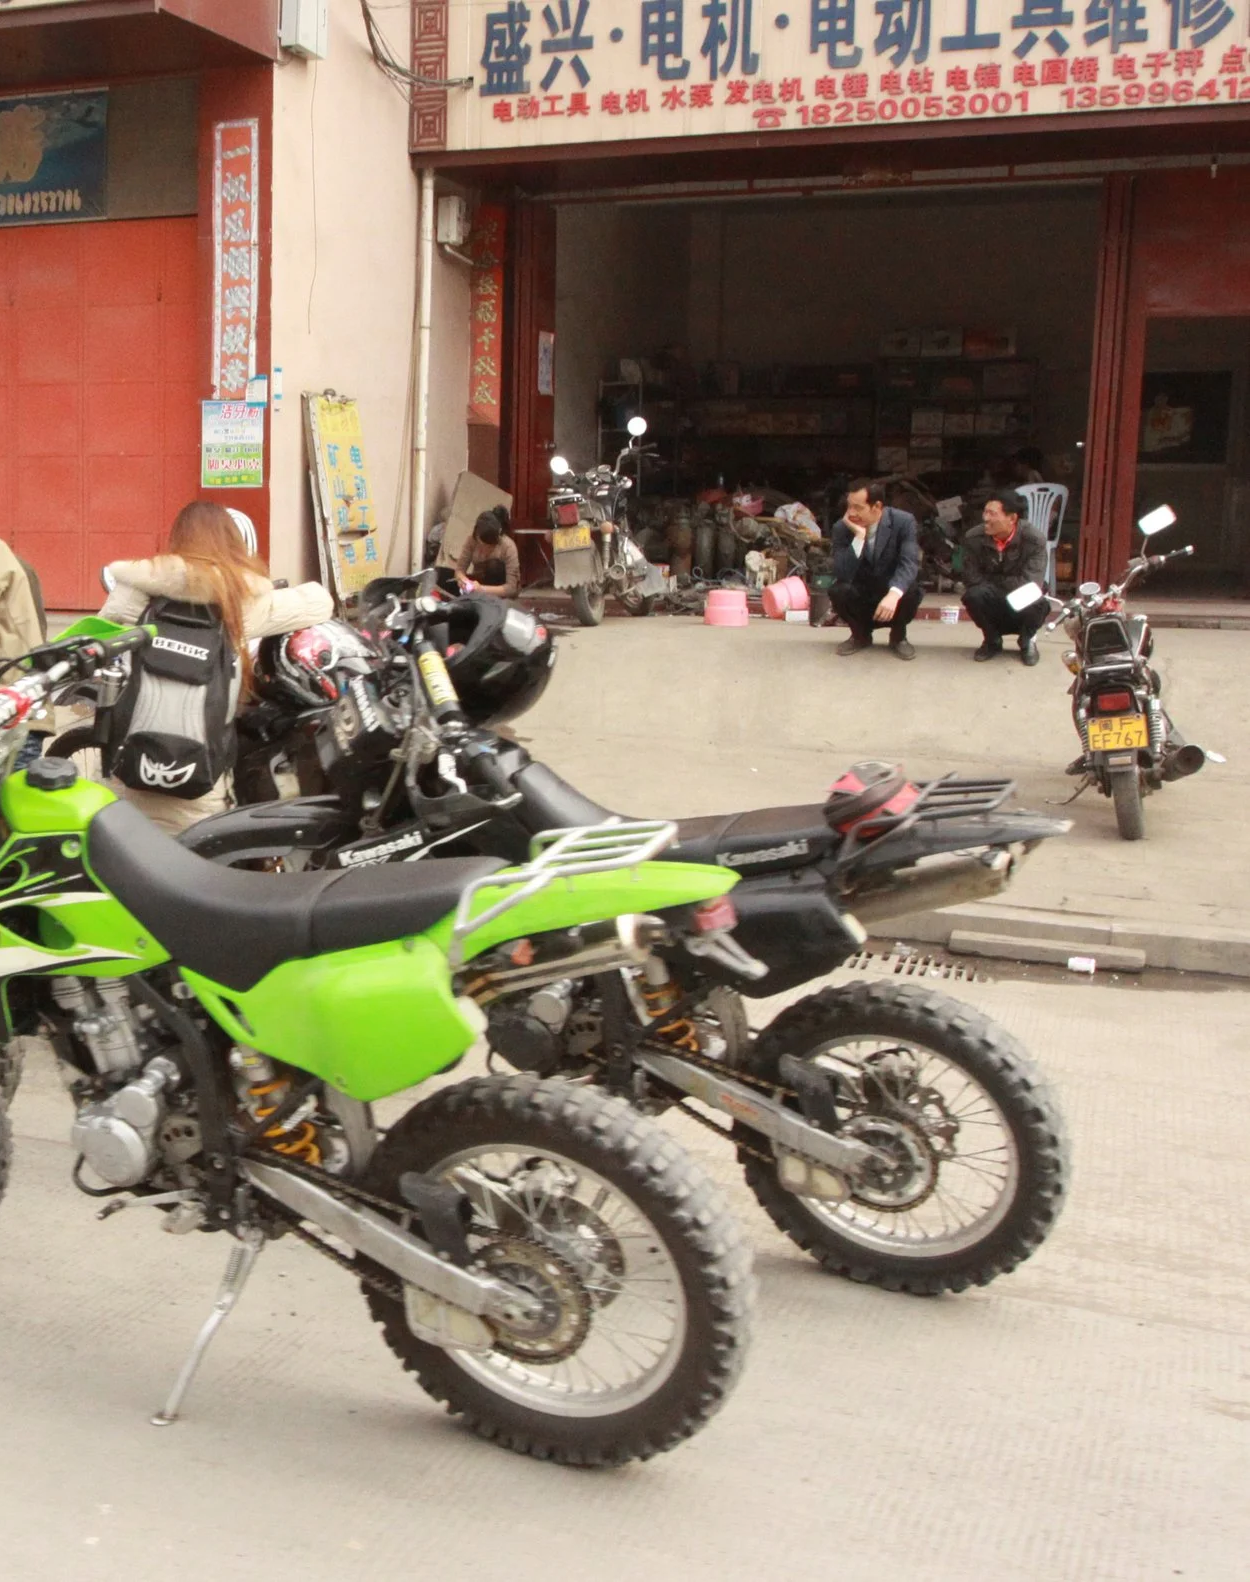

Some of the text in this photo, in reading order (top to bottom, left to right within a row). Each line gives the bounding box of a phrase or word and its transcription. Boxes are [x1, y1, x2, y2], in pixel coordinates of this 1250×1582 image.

[493, 92, 590, 123] 电动工具
[601, 88, 650, 117] 电机
[661, 83, 714, 111] 水泵
[726, 76, 805, 107] 发电机
[815, 72, 869, 100] 电锤
[880, 67, 935, 96] 电钻
[1112, 49, 1205, 80] 电子秤
[1218, 44, 1250, 75] 点
[796, 91, 1030, 126] 18250053001
[151, 636, 210, 661] BERIK
[337, 830, 424, 867] Kawasaki
[715, 838, 809, 868] Kawasaki
